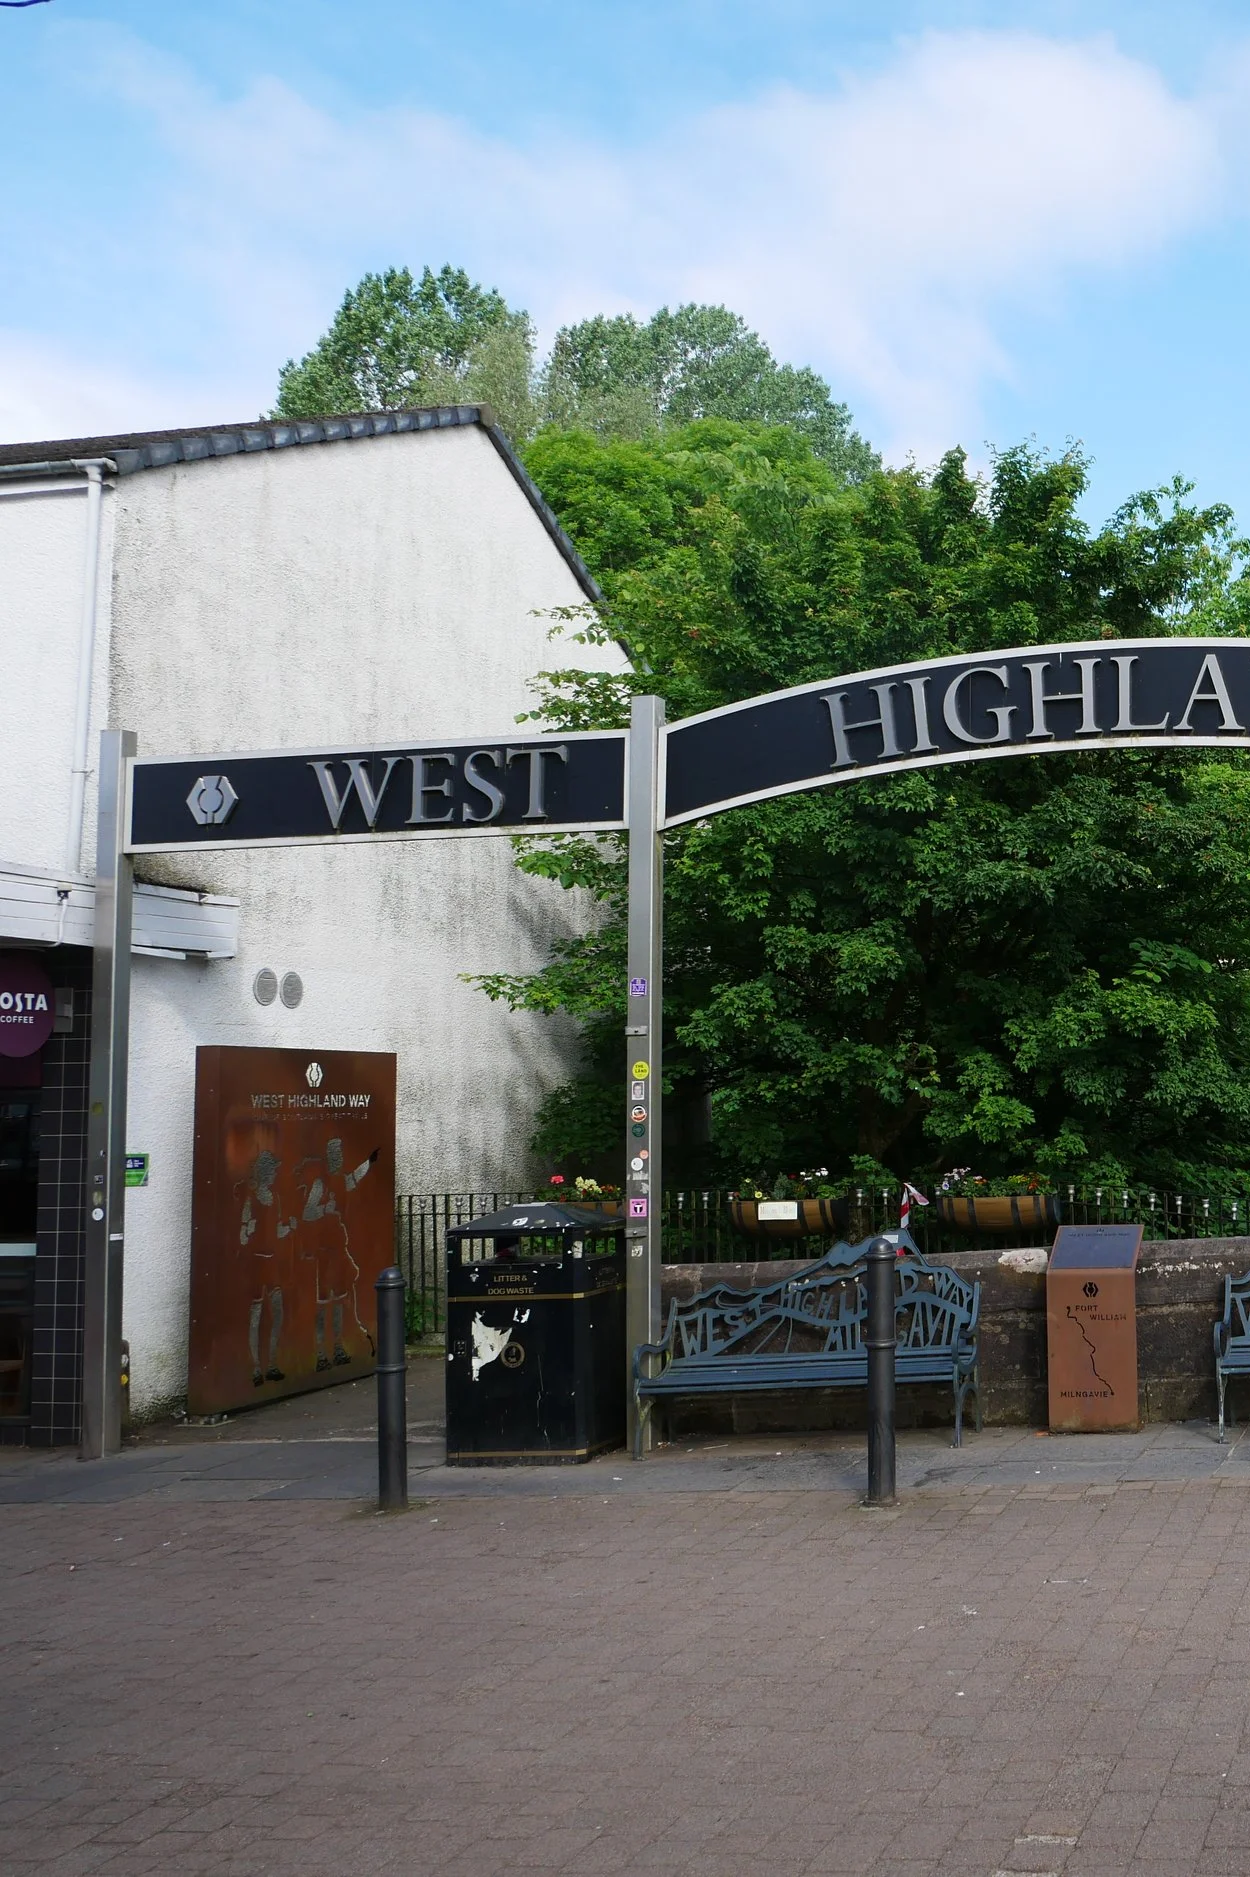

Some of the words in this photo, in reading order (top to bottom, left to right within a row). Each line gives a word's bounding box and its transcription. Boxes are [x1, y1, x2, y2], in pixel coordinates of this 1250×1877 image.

[307, 745, 569, 830] WEST
[0, 1015, 35, 1024] COFFEE
[250, 1094, 285, 1109] WEST
[288, 1094, 346, 1108] HIGHLAND
[348, 1094, 371, 1107] WAY
[521, 1274, 528, 1282] &
[488, 1287, 506, 1295] DOG
[506, 1287, 534, 1295] WASTE
[1075, 1304, 1099, 1312] FORT
[677, 1292, 768, 1358] WEST
[933, 1270, 974, 1312] WAY
[1089, 1313, 1127, 1321] WILLIAM
